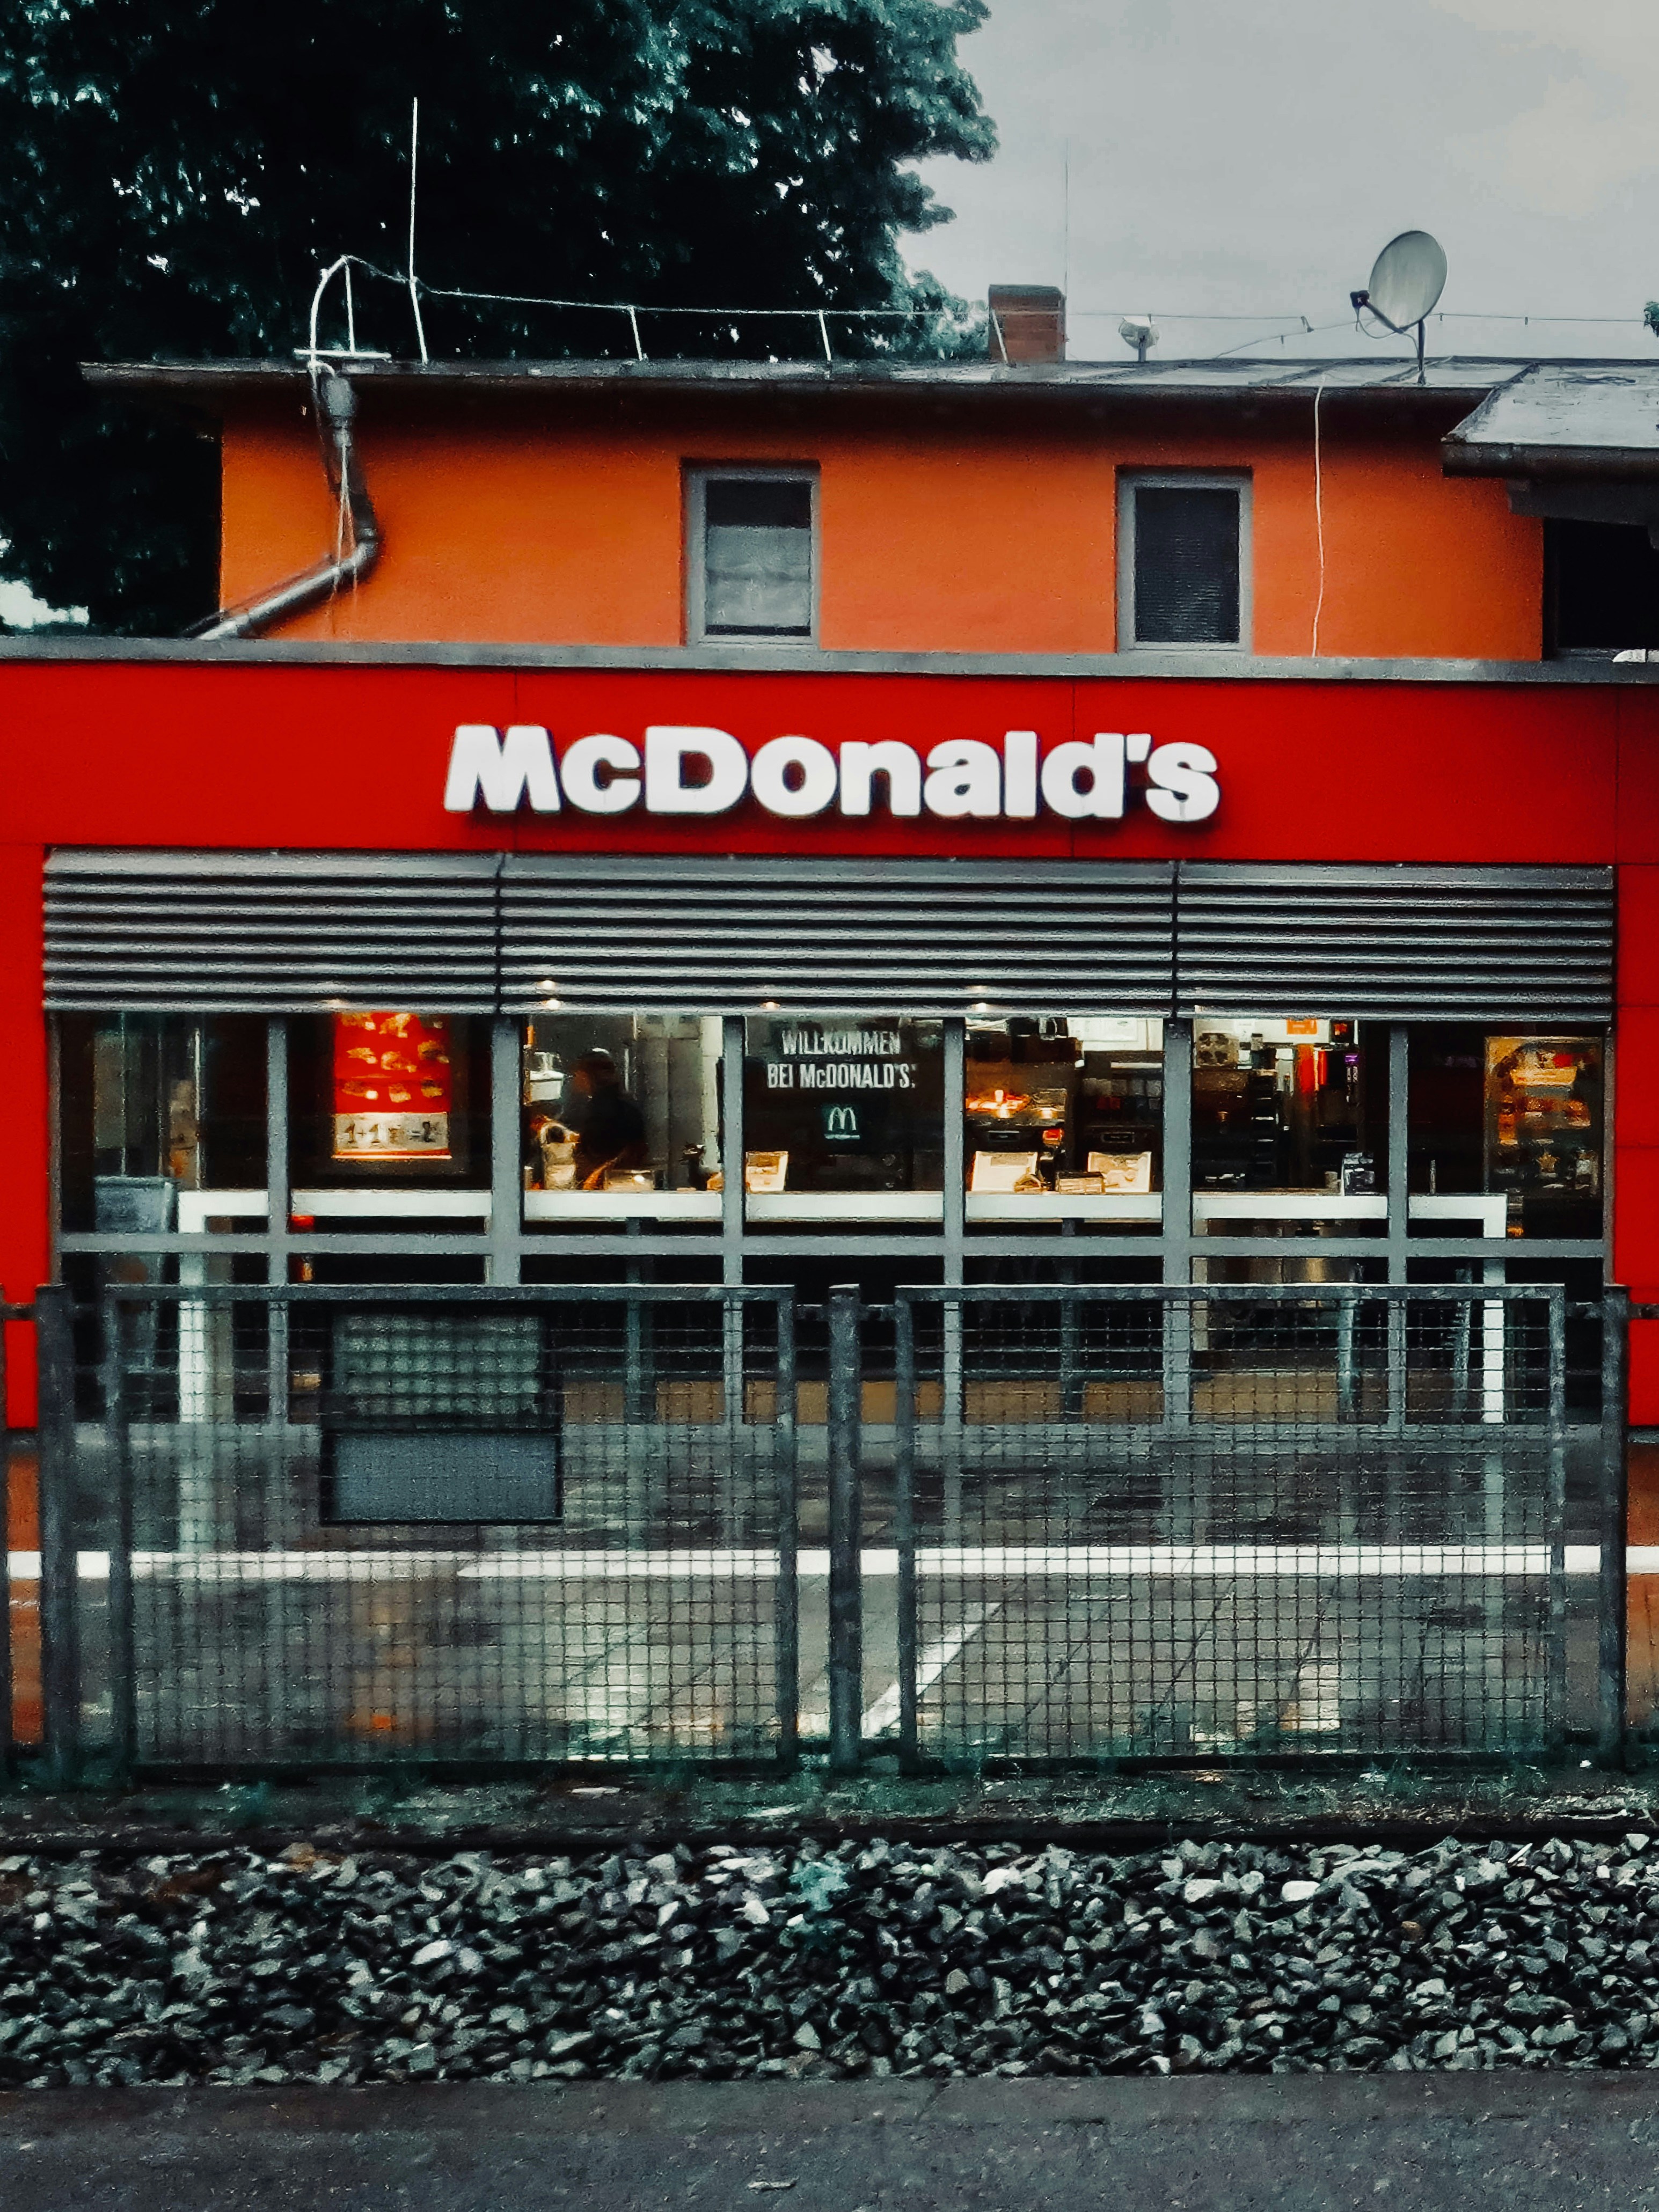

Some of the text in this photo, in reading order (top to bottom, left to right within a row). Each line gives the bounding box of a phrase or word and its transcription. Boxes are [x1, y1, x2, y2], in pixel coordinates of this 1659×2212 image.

[444, 724, 1221, 822] McDonald's
[781, 1030, 901, 1055] WILLKOMMEN
[768, 1063, 794, 1088] BEI
